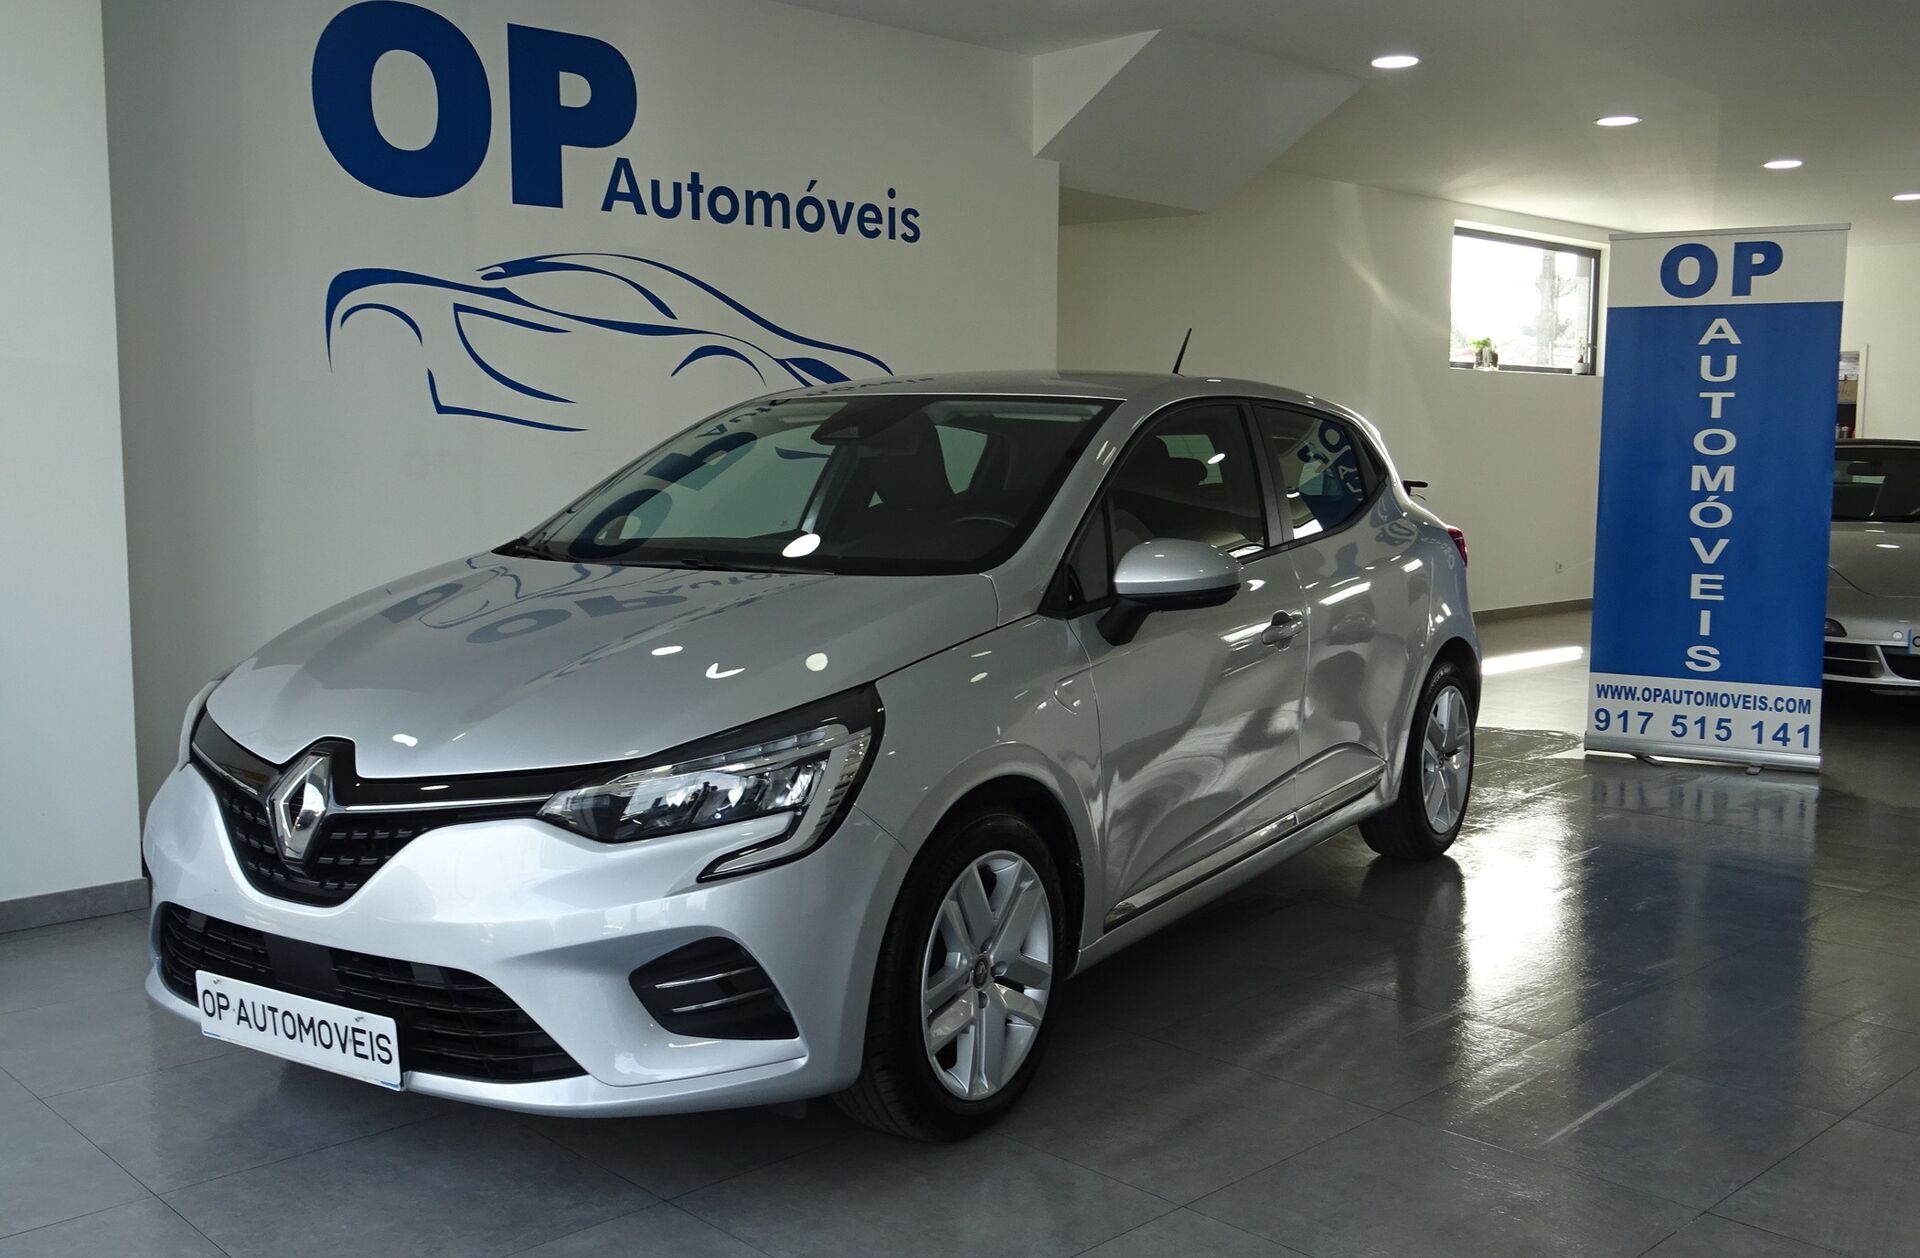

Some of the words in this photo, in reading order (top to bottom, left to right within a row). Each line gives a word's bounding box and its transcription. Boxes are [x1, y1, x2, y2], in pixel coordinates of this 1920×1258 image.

[312, 0, 636, 208] OP
[602, 157, 921, 244] Automóveis
[1660, 240, 1783, 298] OP
[1685, 317, 1742, 673] AUTOMÓVEIS
[1594, 707, 1655, 735] 917
[1670, 713, 1733, 743] 515
[1751, 720, 1811, 749] 141
[1596, 683, 1812, 715] WWW.OPAUTOMOVEIS.COM
[202, 988, 231, 1021] OP
[236, 998, 393, 1066] AUTOMOVEIS
